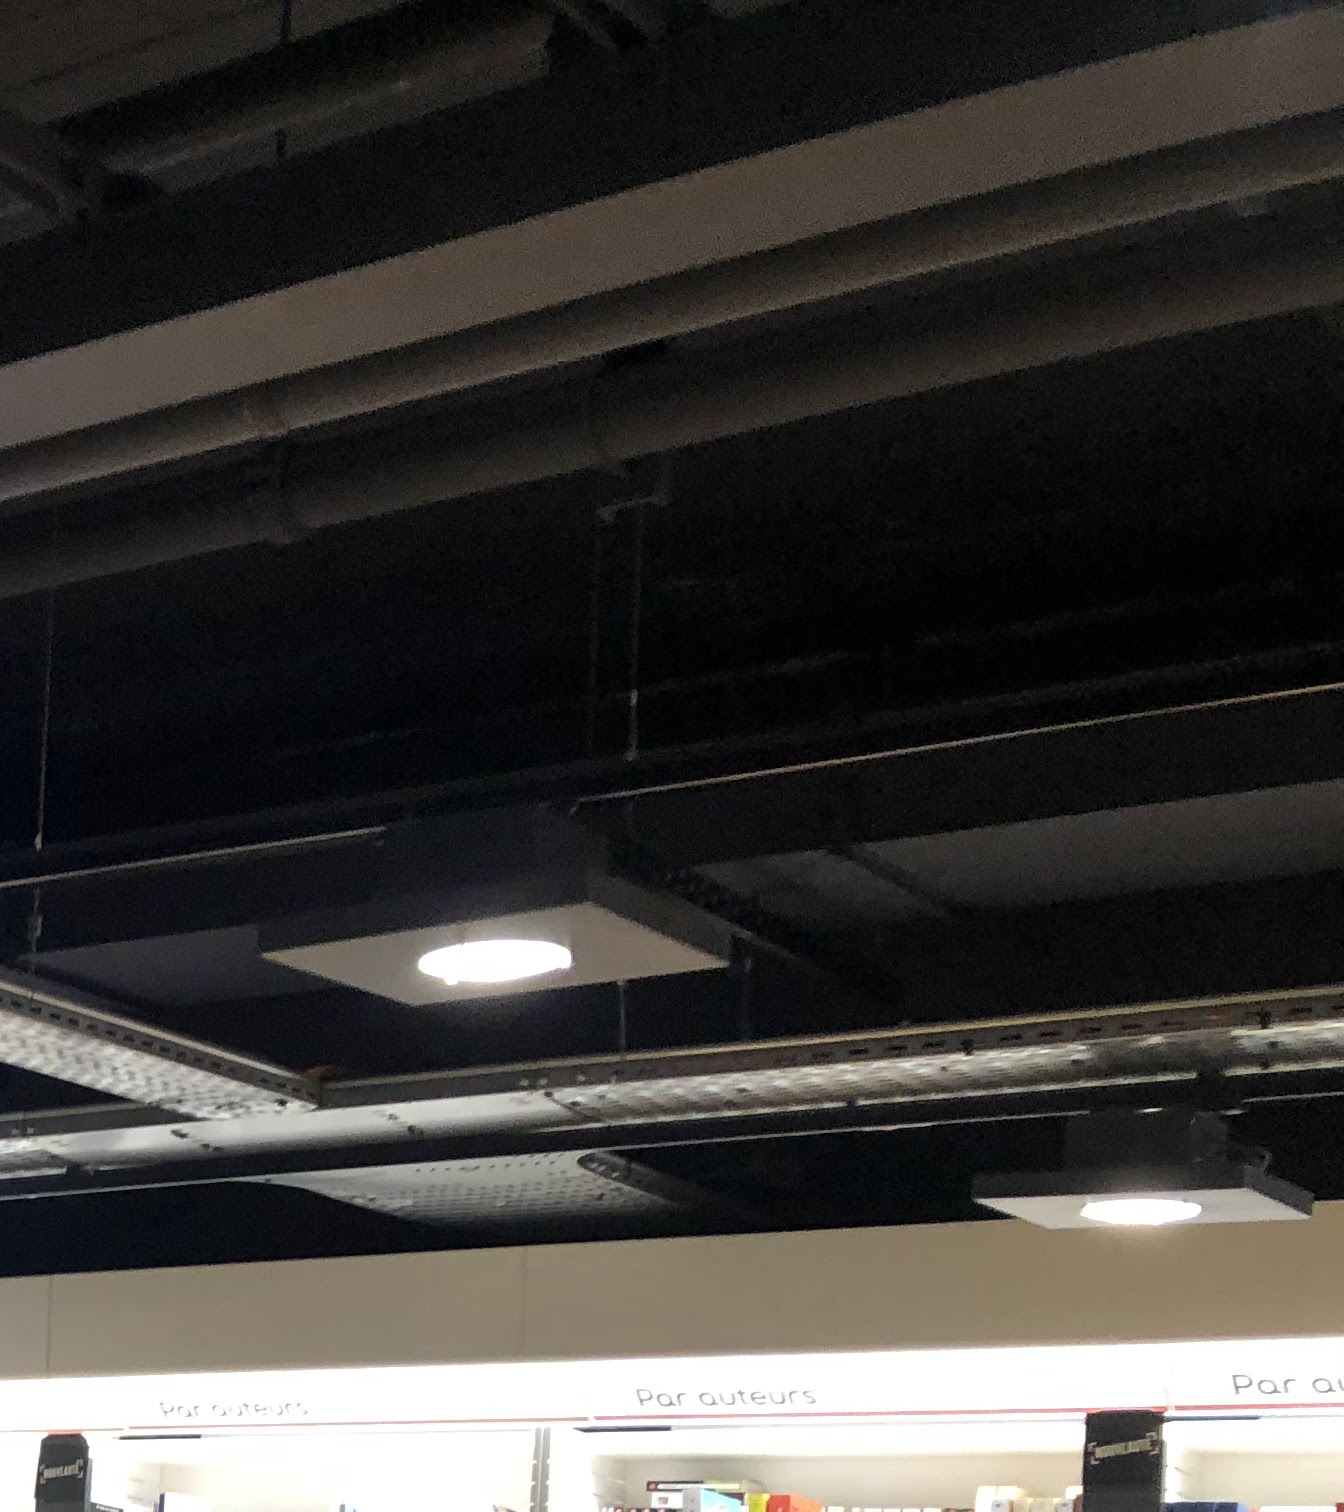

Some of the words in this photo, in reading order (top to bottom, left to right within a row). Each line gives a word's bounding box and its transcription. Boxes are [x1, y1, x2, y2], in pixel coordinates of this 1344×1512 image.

[1231, 1373, 1297, 1395] Par
[636, 1388, 684, 1408] Par
[698, 1386, 817, 1406] auteurs
[160, 1402, 200, 1420] Par
[211, 1399, 310, 1420] auteurs
